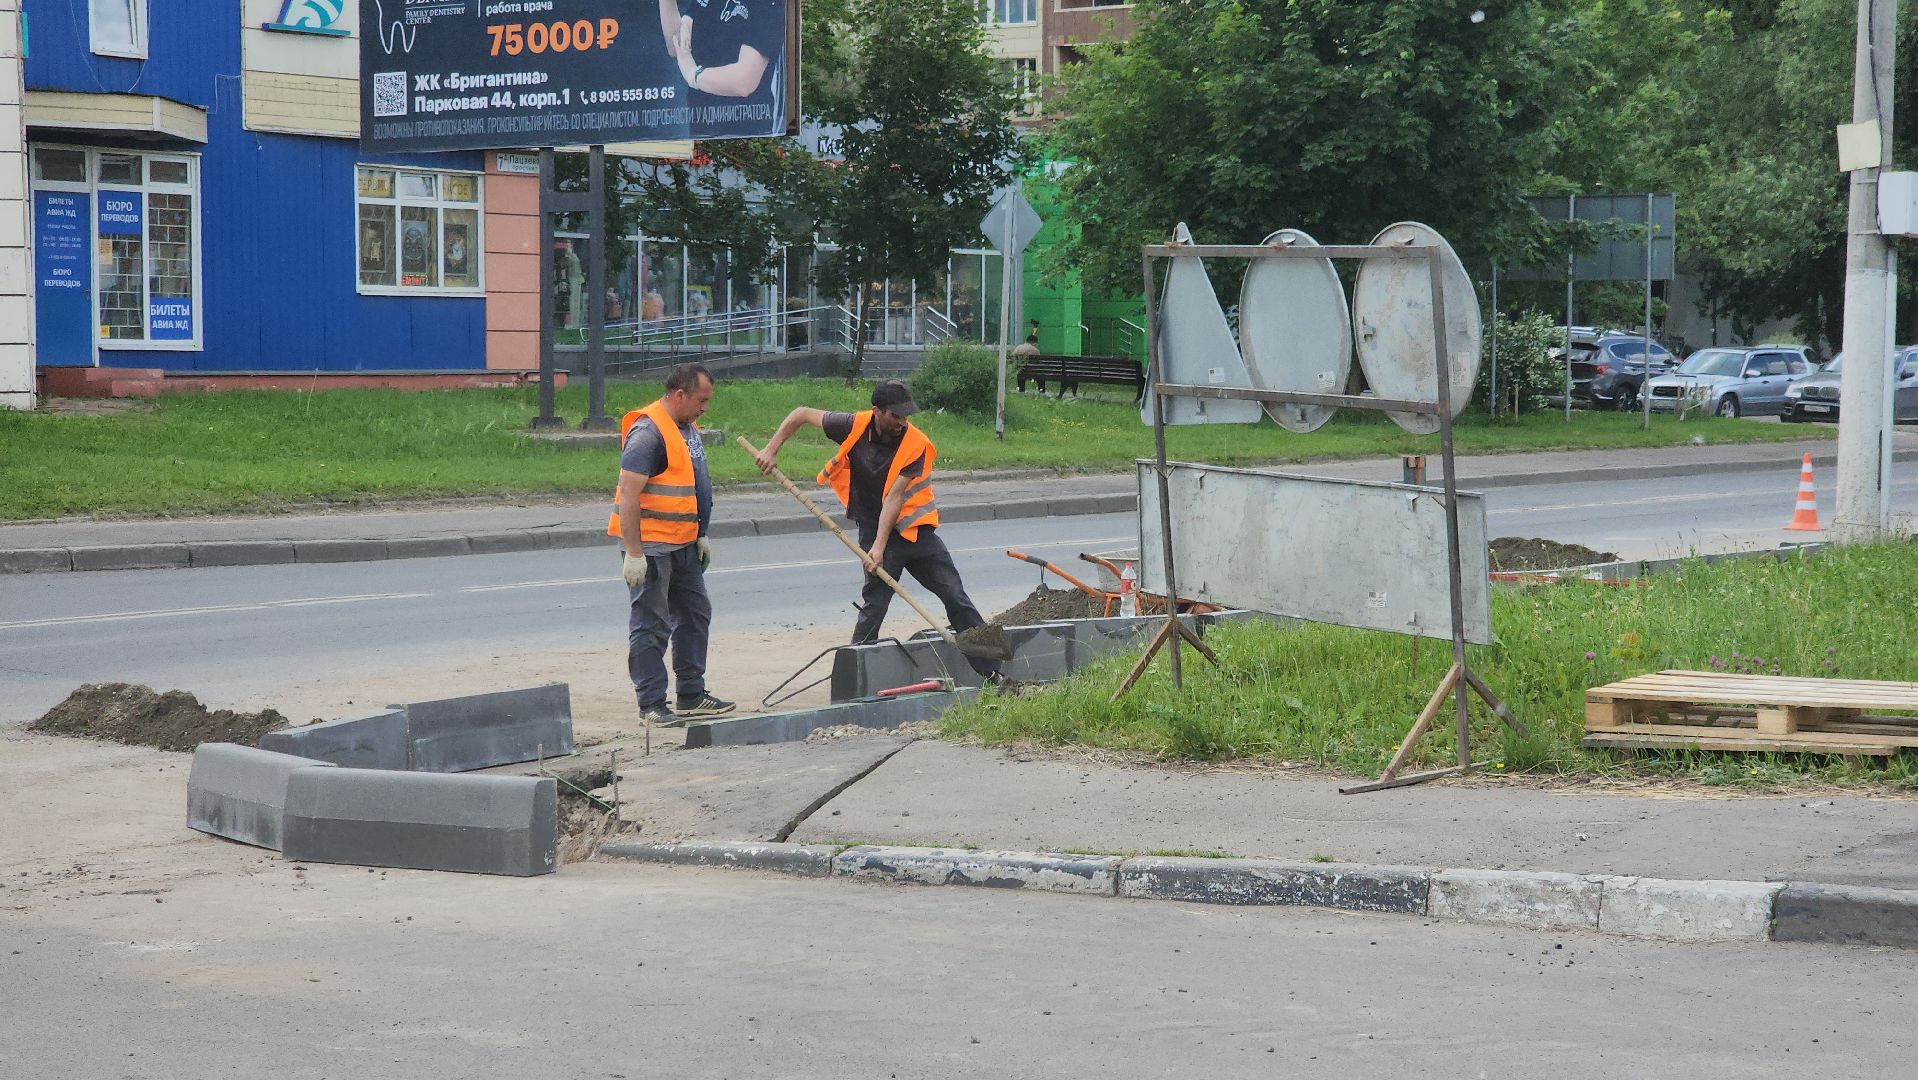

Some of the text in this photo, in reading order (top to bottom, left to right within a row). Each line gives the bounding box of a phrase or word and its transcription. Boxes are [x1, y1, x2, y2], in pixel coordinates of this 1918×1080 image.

[405, 7, 466, 18] FAMILY DENTISTRY
[485, 1, 553, 17] работа врача
[405, 17, 432, 25] CENTER
[414, 71, 548, 92] ЖК «Бригантина»
[590, 86, 675, 103] 8 905 555 83 65
[414, 95, 489, 116] Парковая
[490, 91, 516, 110] 44,
[373, 122, 414, 140] ВОЗМОЖНЫ
[487, 112, 569, 133] ПРОКОНСУЛЬТИРУЙТЕСЬ
[570, 113, 581, 130] СО
[641, 107, 695, 129] ПОДРОБНОСТИ
[696, 106, 702, 124] У
[48, 197, 74, 206] БИЛЕТЫ
[106, 201, 133, 212] БЮРО
[46, 208, 77, 218] АВИА ЖД
[101, 213, 139, 224] ПЕРЕВОДОВ
[52, 268, 72, 276] БЮРО
[44, 279, 81, 289] ПЕРЕВОДОВ
[150, 304, 190, 317] БИЛЕТЫ
[152, 319, 189, 332] АВИА ЖД
